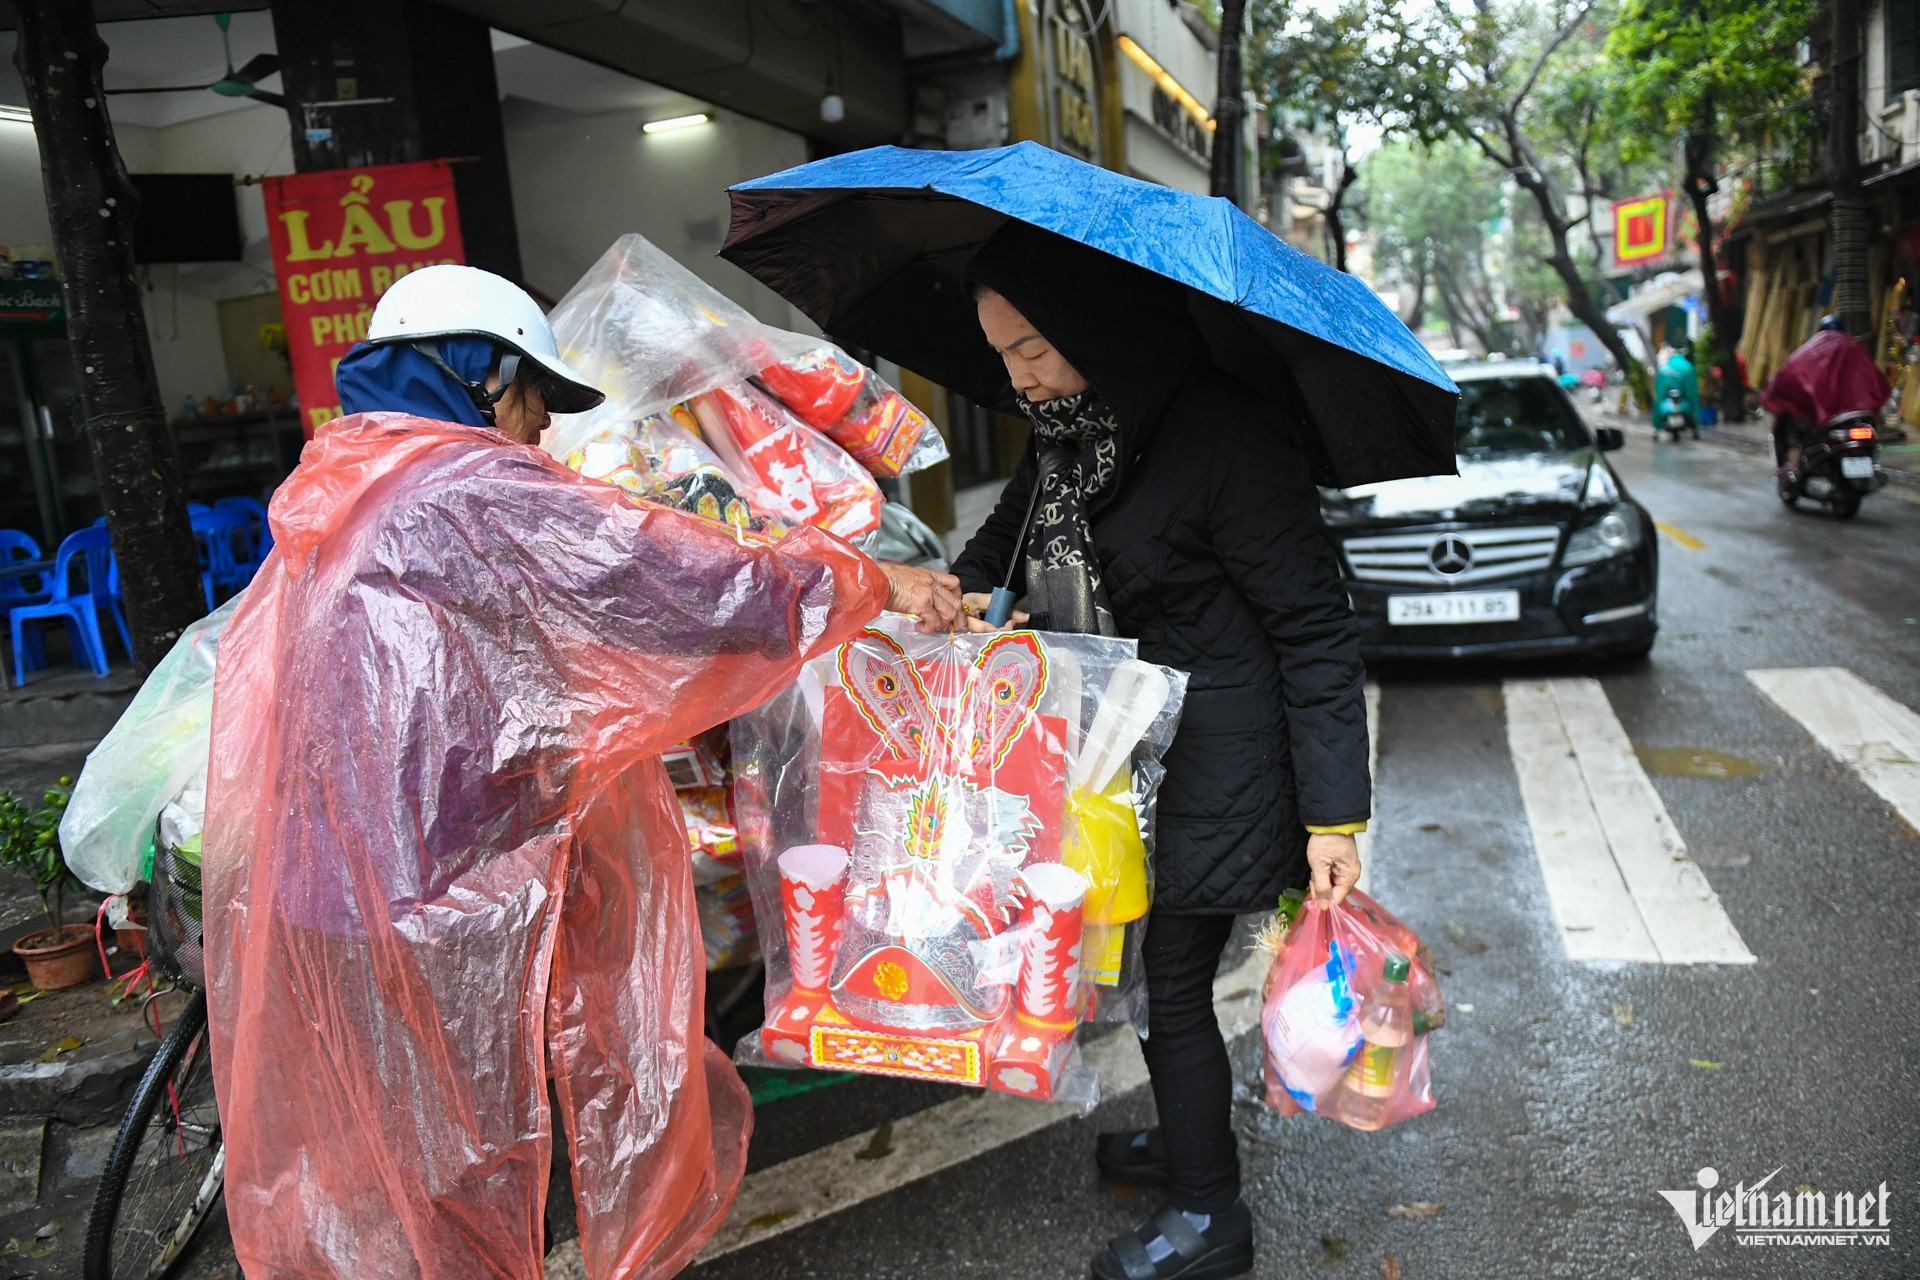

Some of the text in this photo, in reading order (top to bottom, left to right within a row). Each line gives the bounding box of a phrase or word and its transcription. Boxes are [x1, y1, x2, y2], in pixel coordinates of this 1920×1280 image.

[279, 174, 445, 262] LẨU
[287, 258, 457, 304] CƠM RA
